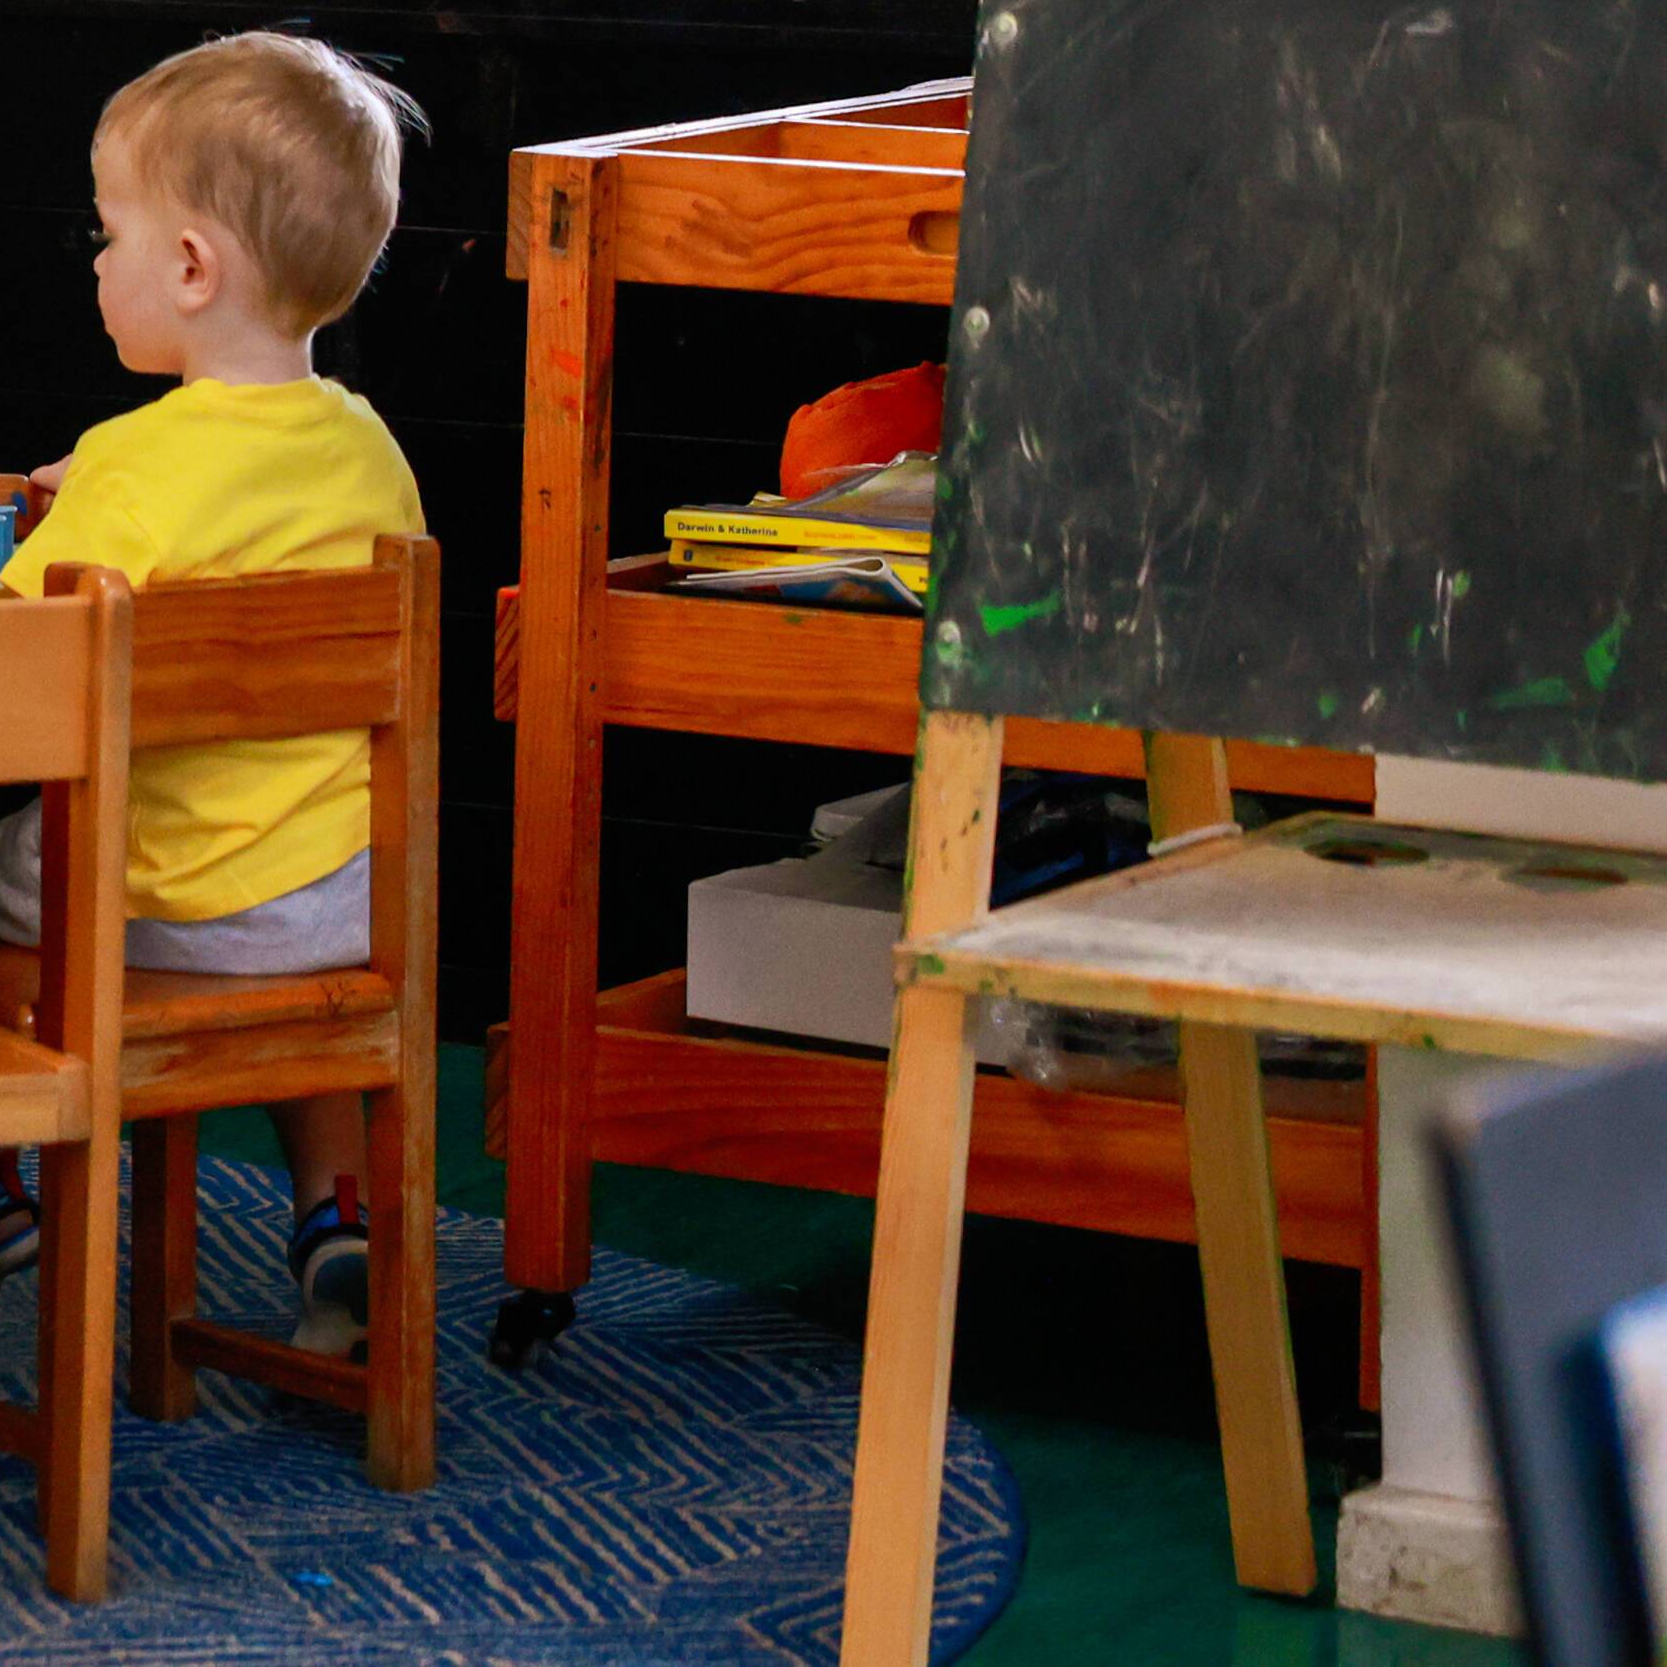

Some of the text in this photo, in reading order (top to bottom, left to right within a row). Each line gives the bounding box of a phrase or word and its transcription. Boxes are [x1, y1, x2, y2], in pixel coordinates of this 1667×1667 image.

[677, 522, 778, 537] Darwin & Katherine
